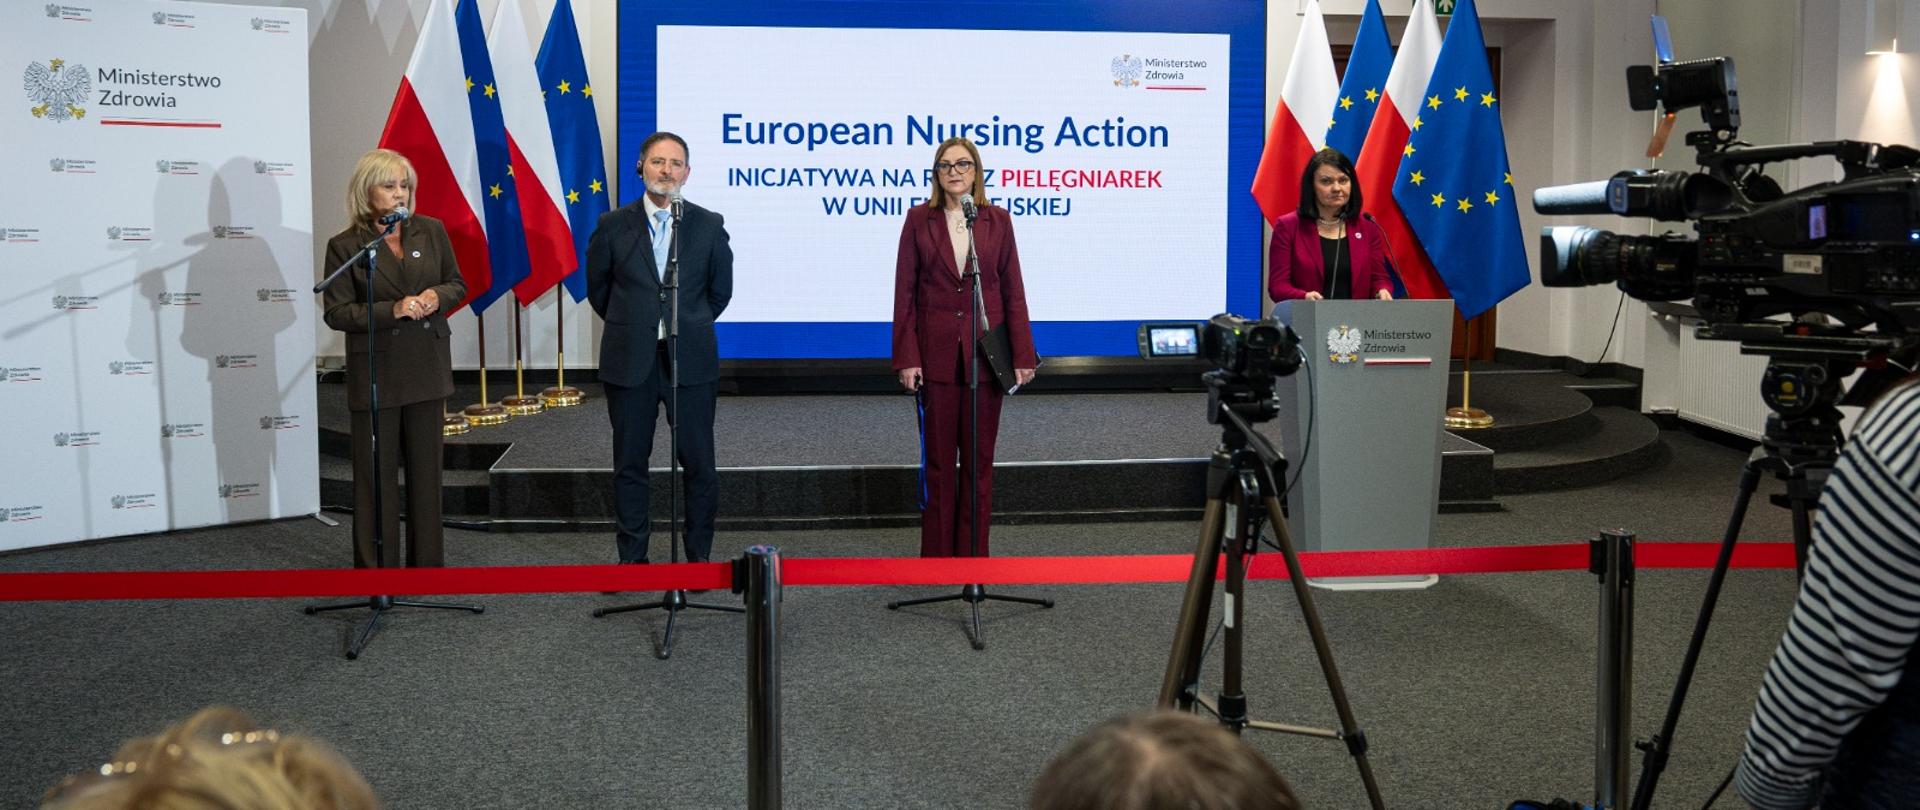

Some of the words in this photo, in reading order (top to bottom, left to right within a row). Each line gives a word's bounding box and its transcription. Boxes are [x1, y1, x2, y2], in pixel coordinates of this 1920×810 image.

[1145, 58, 1207, 68] Ministerstwo
[98, 67, 221, 88] Ministerstwo
[1145, 70, 1184, 80] Zdrowia
[98, 89, 177, 108] Zdrowia
[722, 113, 893, 151] European
[906, 114, 1045, 154] Nursing
[1054, 116, 1169, 148] Action
[728, 168, 875, 187] INICJATYWA
[882, 168, 916, 187] NA
[1001, 169, 1163, 192] PIELĘGNIAREK
[822, 197, 847, 215] W
[854, 197, 902, 216] UNII
[1363, 329, 1432, 340] Ministerstwo
[1363, 343, 1406, 353] Zdrowia
